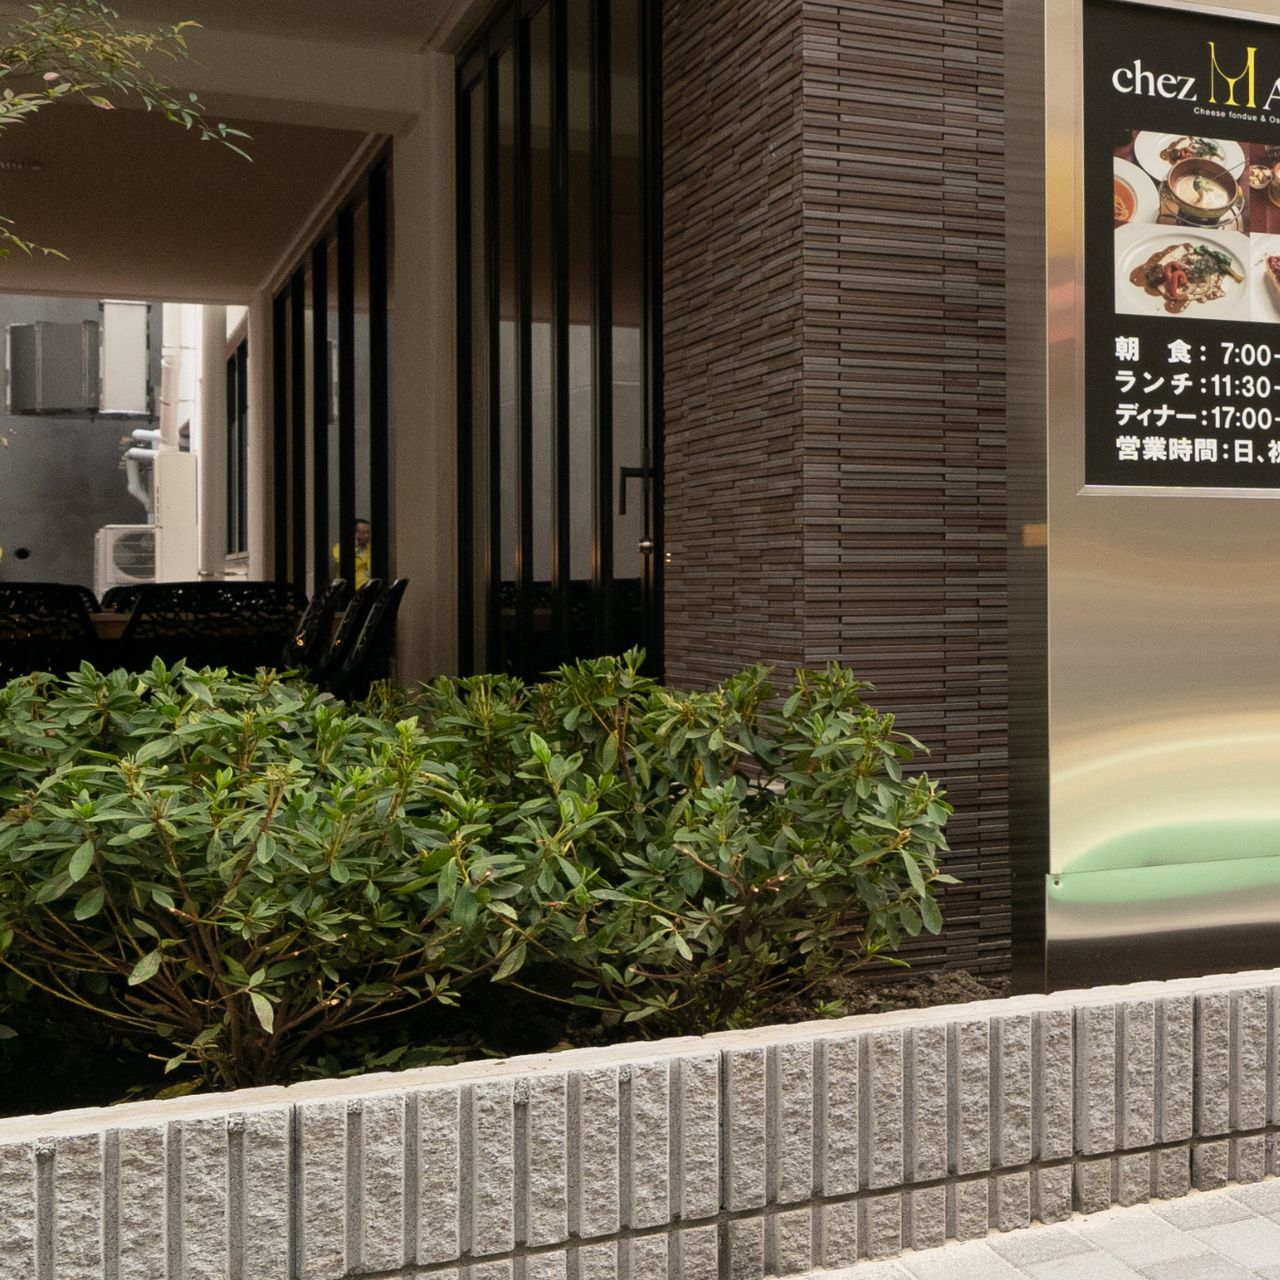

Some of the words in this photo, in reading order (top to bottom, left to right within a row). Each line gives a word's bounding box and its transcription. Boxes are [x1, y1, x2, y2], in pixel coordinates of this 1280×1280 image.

[1111, 59, 1197, 101] chez
[1193, 106, 1226, 118] Cheese
[1228, 111, 1258, 121] fondue
